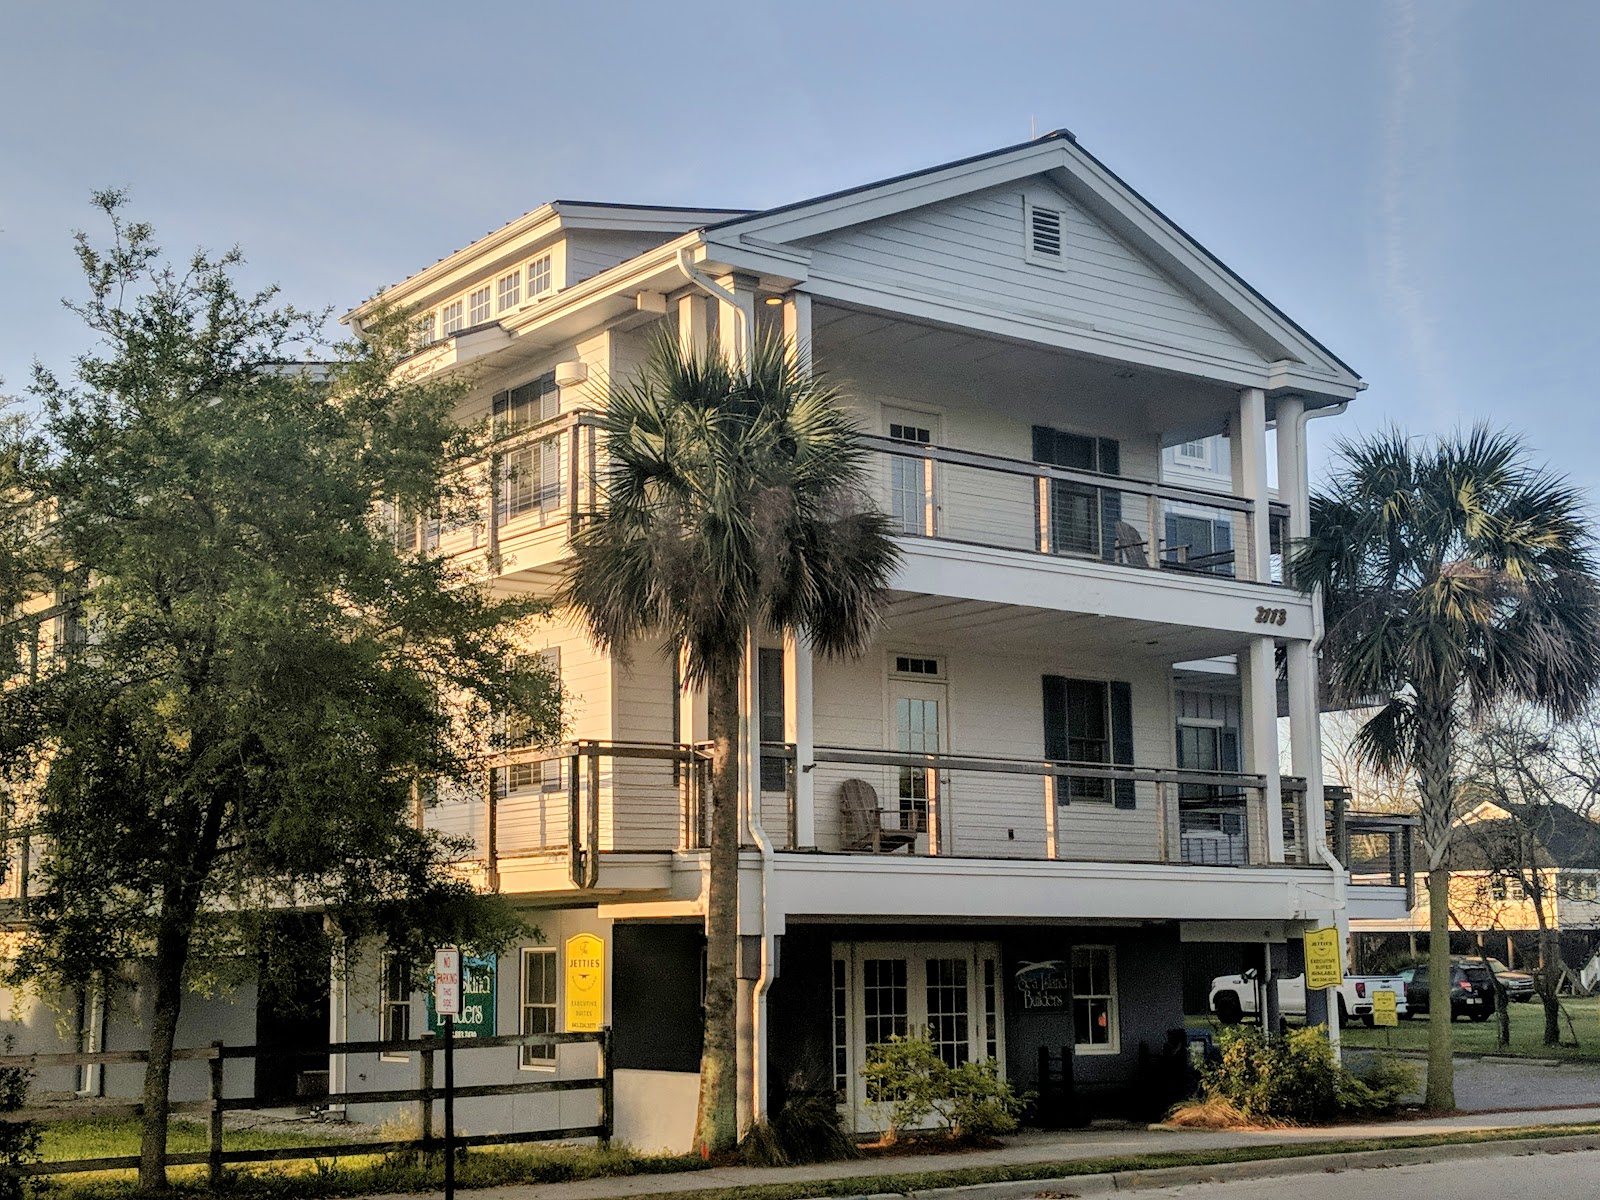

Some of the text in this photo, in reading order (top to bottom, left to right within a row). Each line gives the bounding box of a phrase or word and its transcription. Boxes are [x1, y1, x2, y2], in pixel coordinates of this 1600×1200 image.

[443, 956, 450, 968] NO
[569, 958, 600, 968] JETTIES
[436, 973, 458, 984] PARKING
[443, 987, 452, 996] THIS
[443, 998, 452, 1007] SIDE
[1024, 990, 1063, 1009] Builders
